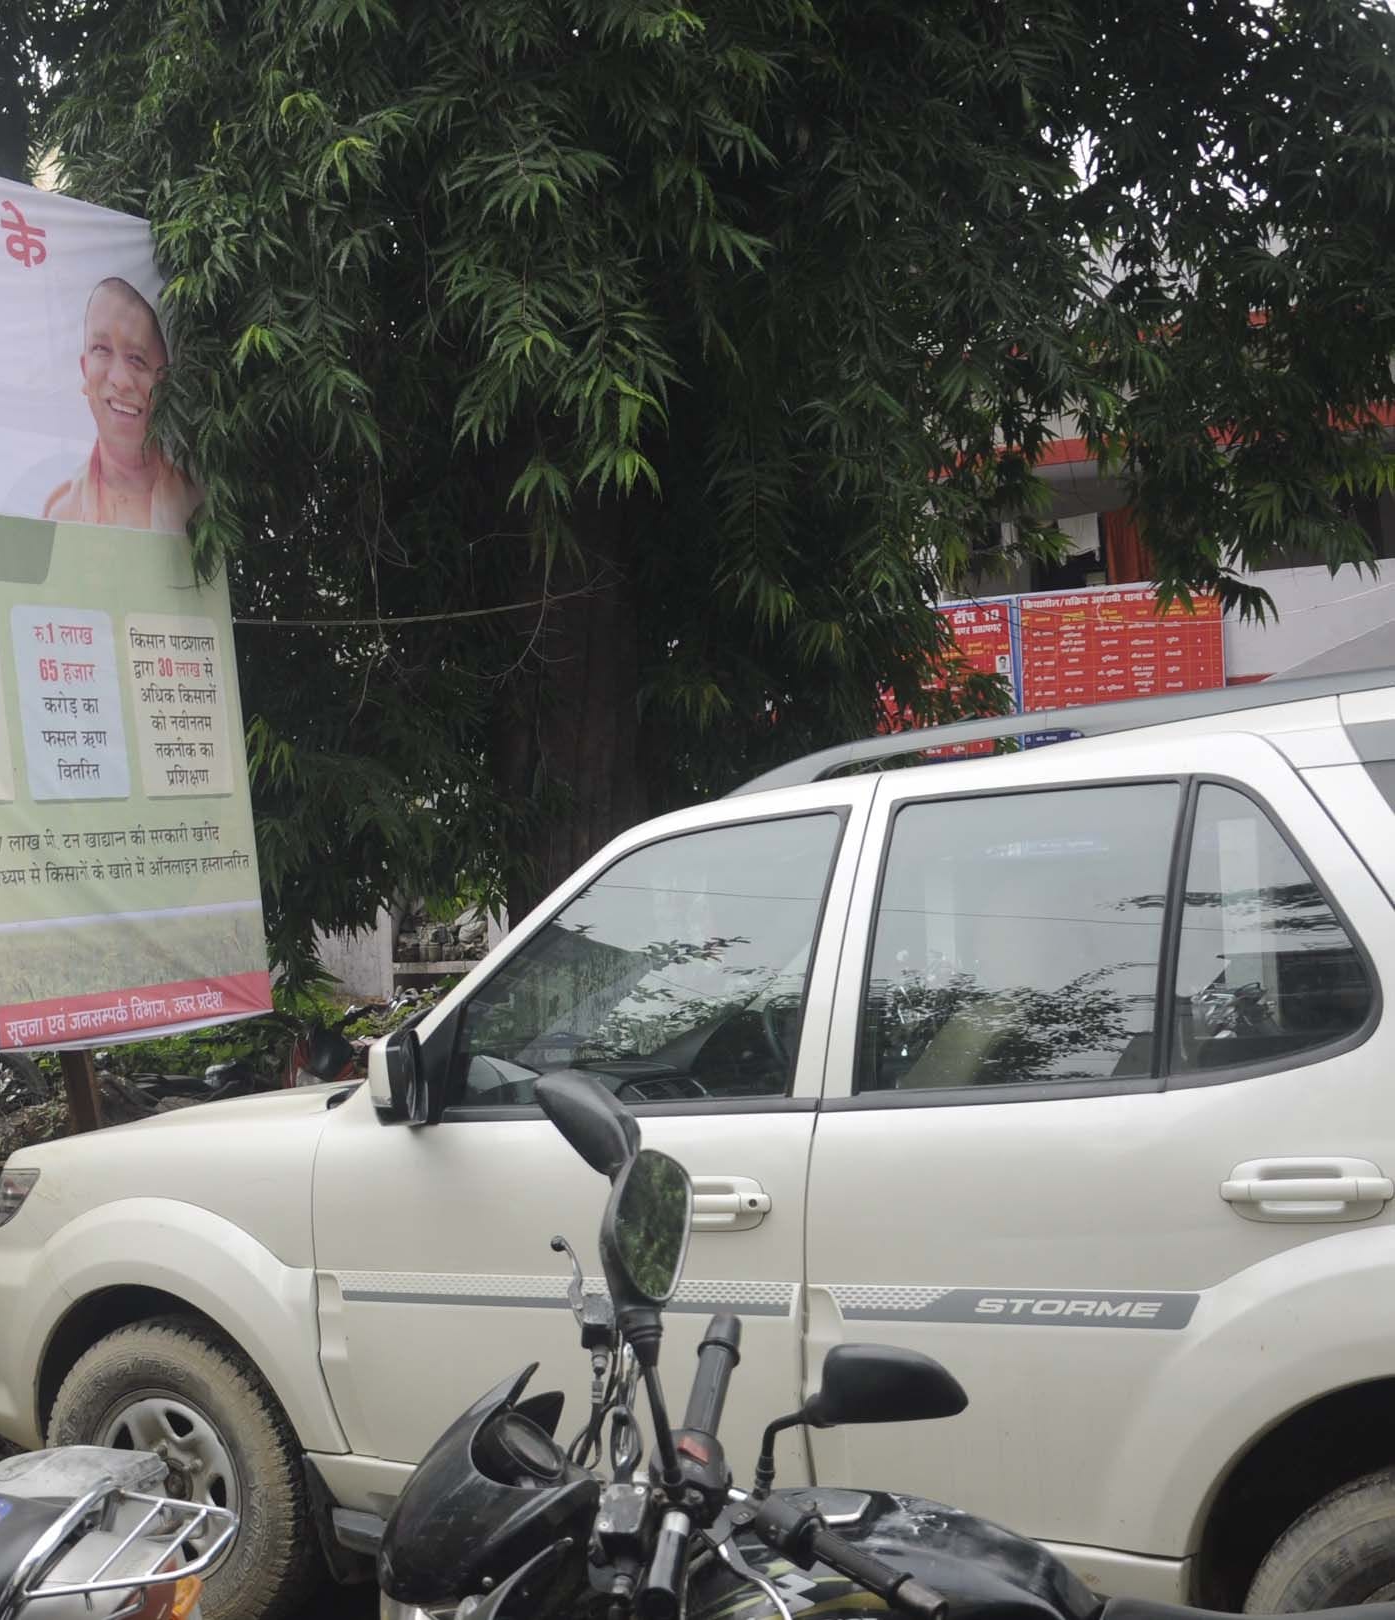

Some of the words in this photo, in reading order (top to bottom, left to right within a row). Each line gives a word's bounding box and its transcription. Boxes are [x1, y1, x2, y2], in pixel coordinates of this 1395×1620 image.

[2, 200, 47, 268] के
[59, 625, 94, 645] लाख
[130, 627, 166, 649] किसान
[39, 658, 60, 682] 65
[61, 663, 96, 684] हजार
[157, 657, 174, 678] 30
[175, 661, 201, 679] लाख
[42, 691, 78, 718] करोड़
[81, 698, 100, 714] का
[141, 682, 175, 704] अधिक
[178, 683, 217, 705] किसानों
[150, 710, 167, 731] को
[169, 709, 212, 731] नवीनतम
[42, 730, 78, 748] फसल
[81, 730, 108, 749] ऋण
[155, 737, 196, 759] तकनीक
[199, 742, 214, 758] का
[57, 758, 101, 781] वितरित
[166, 764, 209, 788] प्रशिक्षण
[7, 834, 41, 852] लाख
[129, 824, 146, 845] की
[149, 822, 188, 844] सरकारी
[190, 821, 221, 843] खरीद
[29, 862, 42, 884] से
[91, 859, 106, 880] के
[107, 857, 134, 879] खाते
[6, 1017, 45, 1047] सूचना
[46, 1007, 67, 1035] एवं
[69, 999, 129, 1031] जनसम्पर्क
[198, 985, 224, 1010] प्रदेश
[974, 1297, 1164, 1319] STORME
